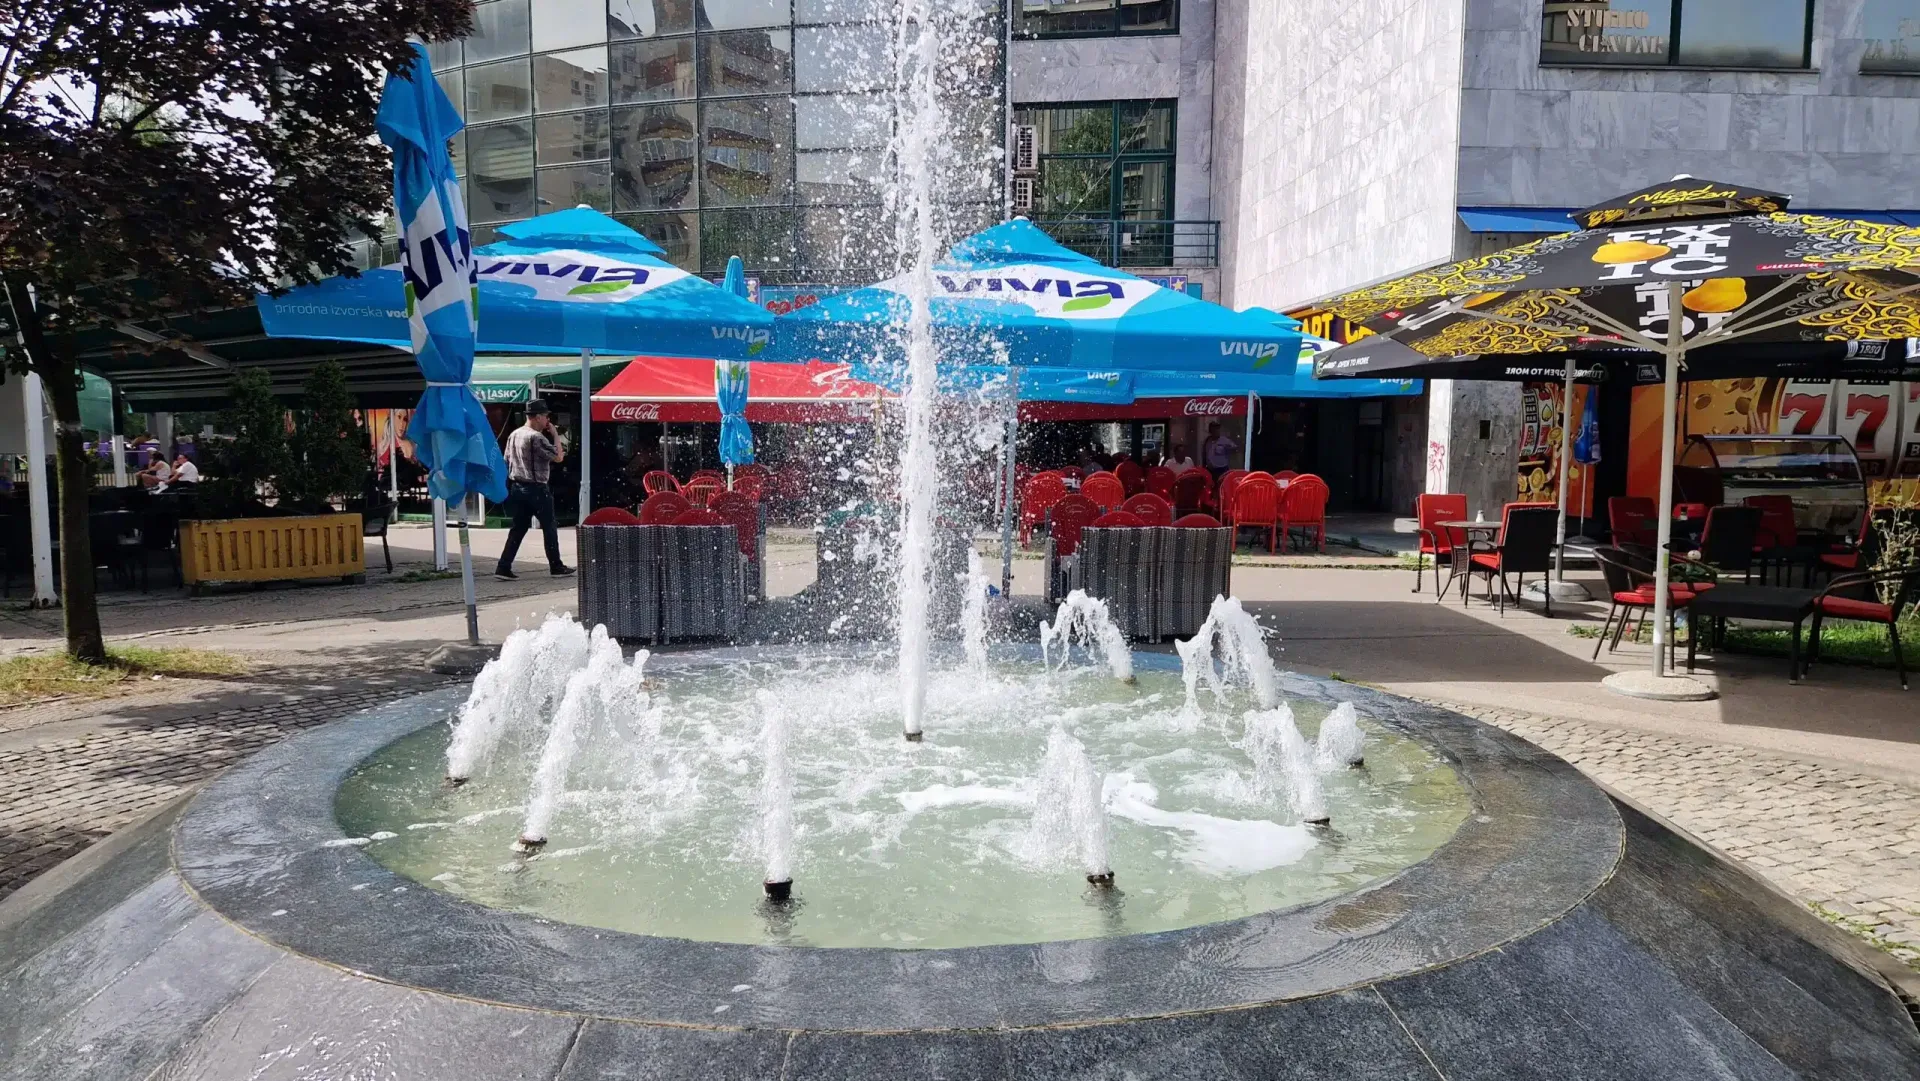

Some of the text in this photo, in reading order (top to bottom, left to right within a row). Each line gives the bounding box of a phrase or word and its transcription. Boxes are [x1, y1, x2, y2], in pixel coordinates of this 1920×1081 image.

[274, 303, 410, 319] prirodna izvorska vod
